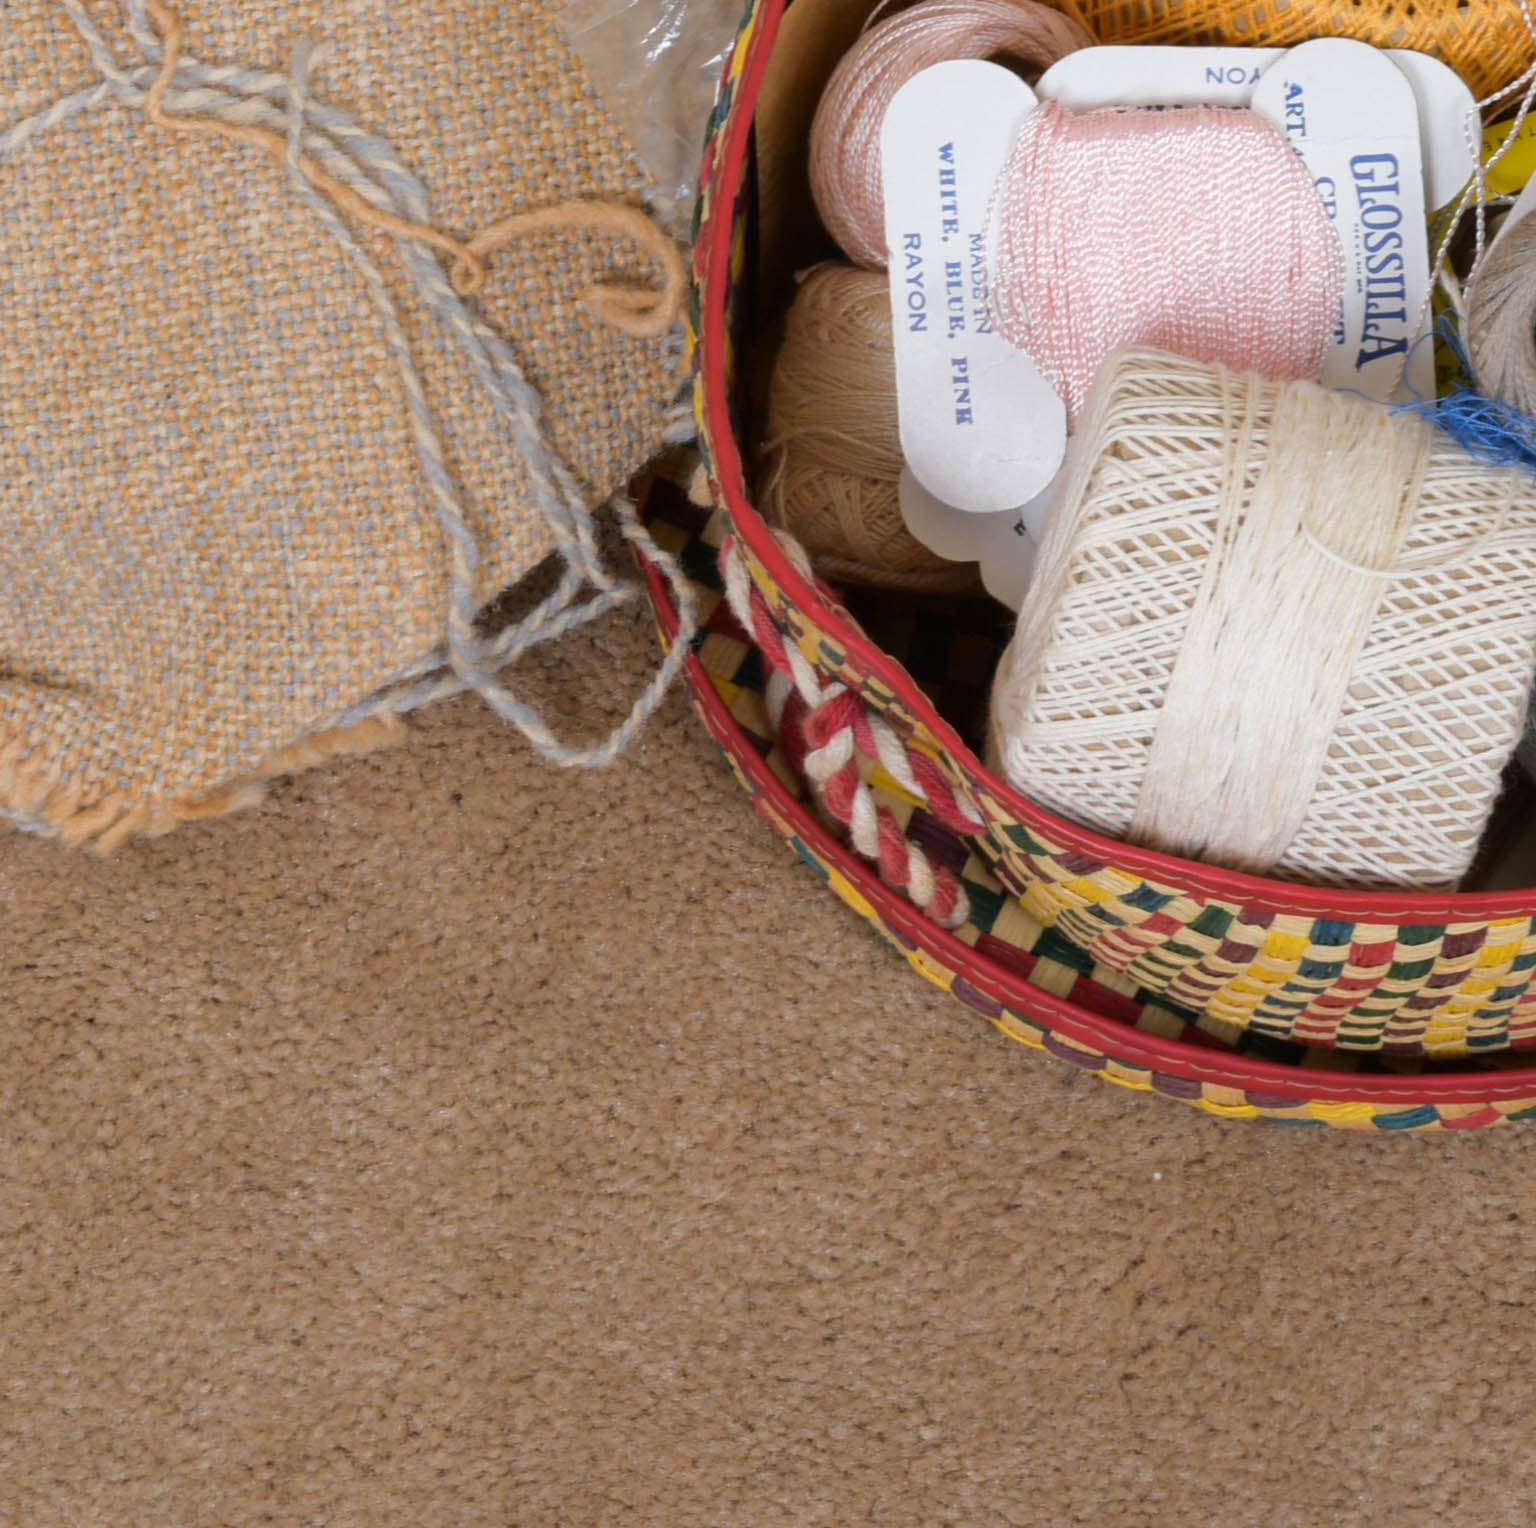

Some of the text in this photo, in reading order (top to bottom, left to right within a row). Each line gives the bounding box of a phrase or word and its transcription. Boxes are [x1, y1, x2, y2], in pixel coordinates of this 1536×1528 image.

[1205, 66, 1261, 85] YON
[902, 232, 928, 333] RAYON
[1349, 152, 1408, 372] GLOSSILLA
